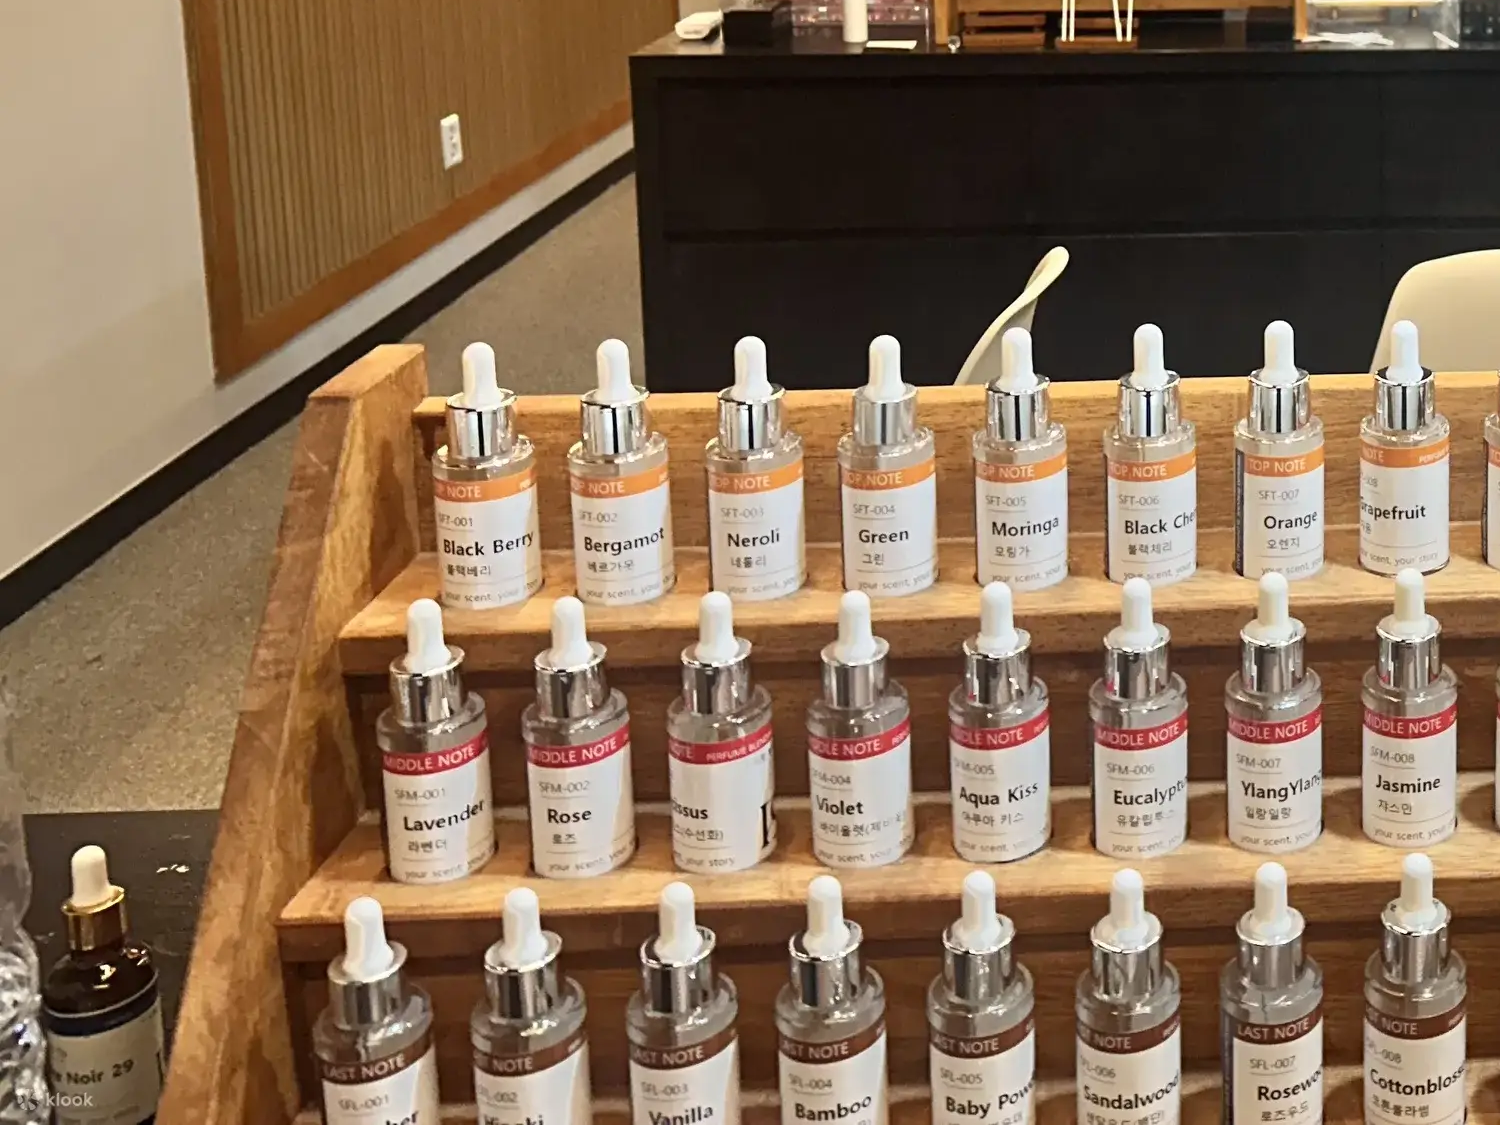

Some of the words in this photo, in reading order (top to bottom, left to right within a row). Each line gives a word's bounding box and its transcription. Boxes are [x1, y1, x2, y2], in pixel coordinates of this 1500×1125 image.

[999, 464, 1035, 479] NOTE
[1132, 464, 1168, 479] NOTE
[1248, 457, 1270, 472] TOP
[1274, 458, 1306, 475] NOTE
[589, 480, 625, 497] NOTE
[735, 474, 771, 491] NOTE
[866, 472, 903, 488] NOTE
[447, 484, 481, 499] NOTE
[1118, 493, 1161, 506] SFT-006
[1258, 487, 1300, 502] SFT-007
[852, 503, 896, 516] SFT-004
[985, 494, 1027, 508] SFT-005
[992, 516, 1059, 538] Moringa
[1124, 518, 1168, 536] Black
[1264, 510, 1318, 533] Orange
[443, 537, 485, 556] Black
[492, 530, 534, 555] Berry
[584, 527, 666, 557] Bergamot
[727, 527, 780, 549] Neroli
[859, 528, 909, 545] Green
[1267, 536, 1301, 550] 오렌지
[861, 552, 885, 566] 그린
[1148, 722, 1181, 745] NOTE
[1275, 721, 1309, 740] NOTE
[1408, 716, 1442, 736] NOTE
[843, 738, 881, 756] NOTE
[986, 731, 1024, 747] NOTE
[437, 744, 476, 767] NOTE
[580, 738, 618, 761] NOTE
[1236, 753, 1282, 769] SFM-007
[1375, 774, 1441, 794] Jasmine
[958, 786, 1000, 808] Aqua
[1007, 782, 1039, 803] Kiss
[815, 794, 864, 816] Violet
[403, 798, 485, 833] Lavender
[547, 807, 592, 825] Rose
[1237, 1024, 1269, 1041] LAST
[1273, 1020, 1310, 1041] NOTE
[1380, 1019, 1418, 1035] NOTE
[808, 1040, 849, 1060] NOTE
[958, 1037, 1001, 1054] NOTE
[1094, 1032, 1132, 1050] NOTE
[492, 1057, 534, 1073] NOTE
[661, 1046, 705, 1066] NOTE
[1249, 1055, 1296, 1071] SFL-007
[66, 1069, 105, 1087] Noir
[111, 1058, 134, 1079] 29
[361, 1055, 406, 1079] NOTE
[1083, 1070, 1180, 1110] Sandalwood
[648, 1106, 714, 1125] Vanilla
[794, 1095, 873, 1122] Bamboo
[945, 1095, 991, 1120] Baby
